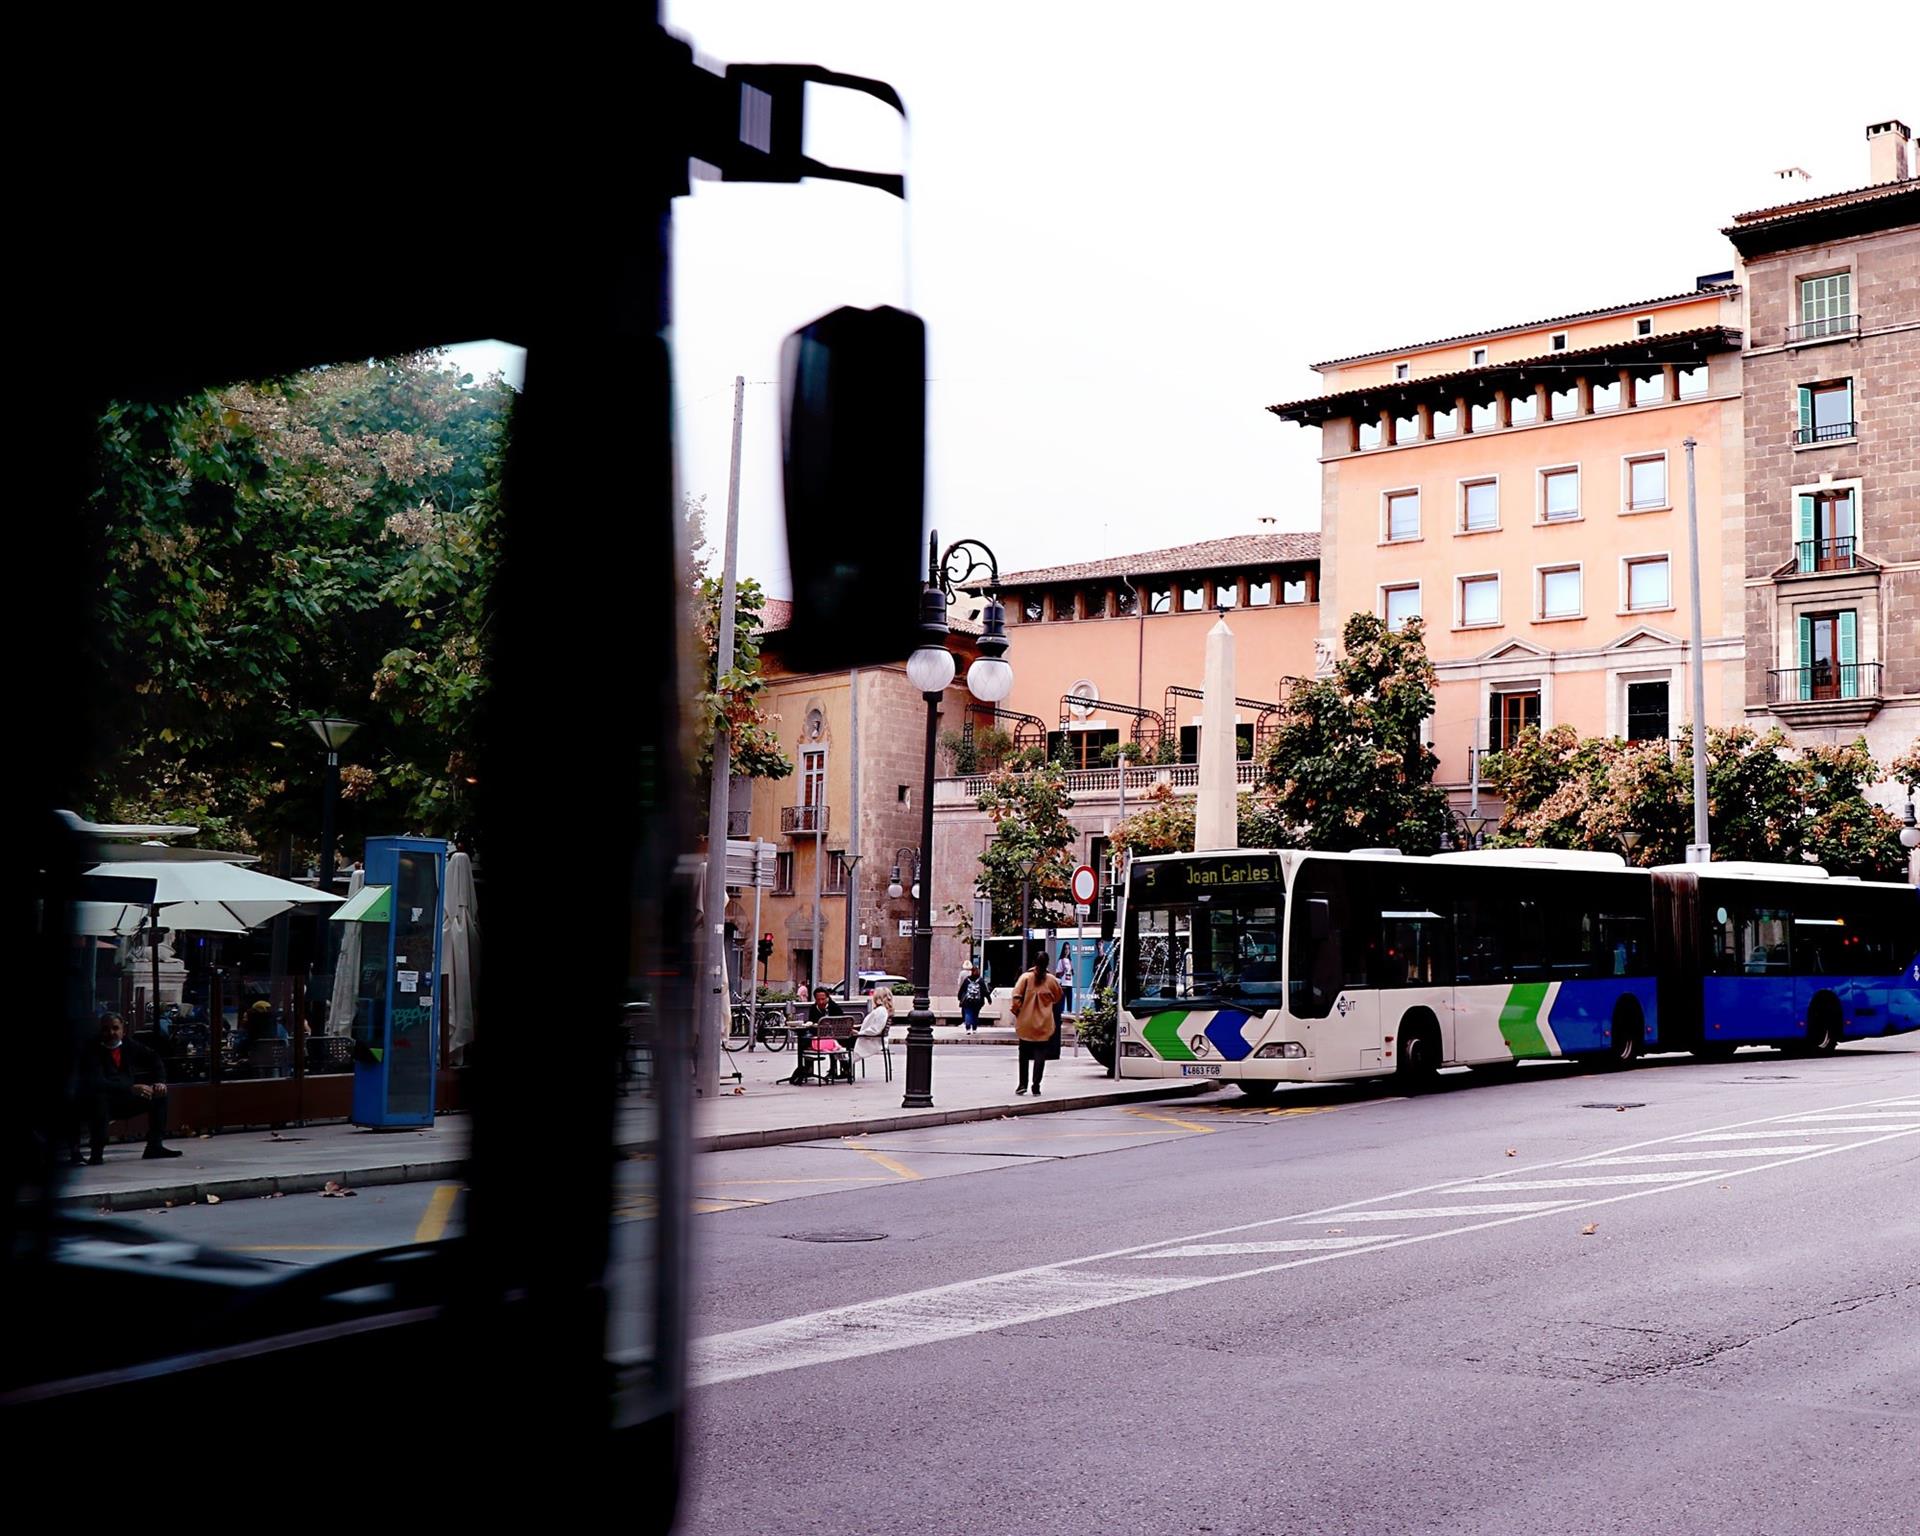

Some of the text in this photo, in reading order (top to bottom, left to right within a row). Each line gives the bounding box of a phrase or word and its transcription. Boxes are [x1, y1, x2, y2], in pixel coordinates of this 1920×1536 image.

[1145, 868, 1155, 886] 3
[1186, 865, 1218, 884] Joan
[1222, 863, 1270, 882] Carles
